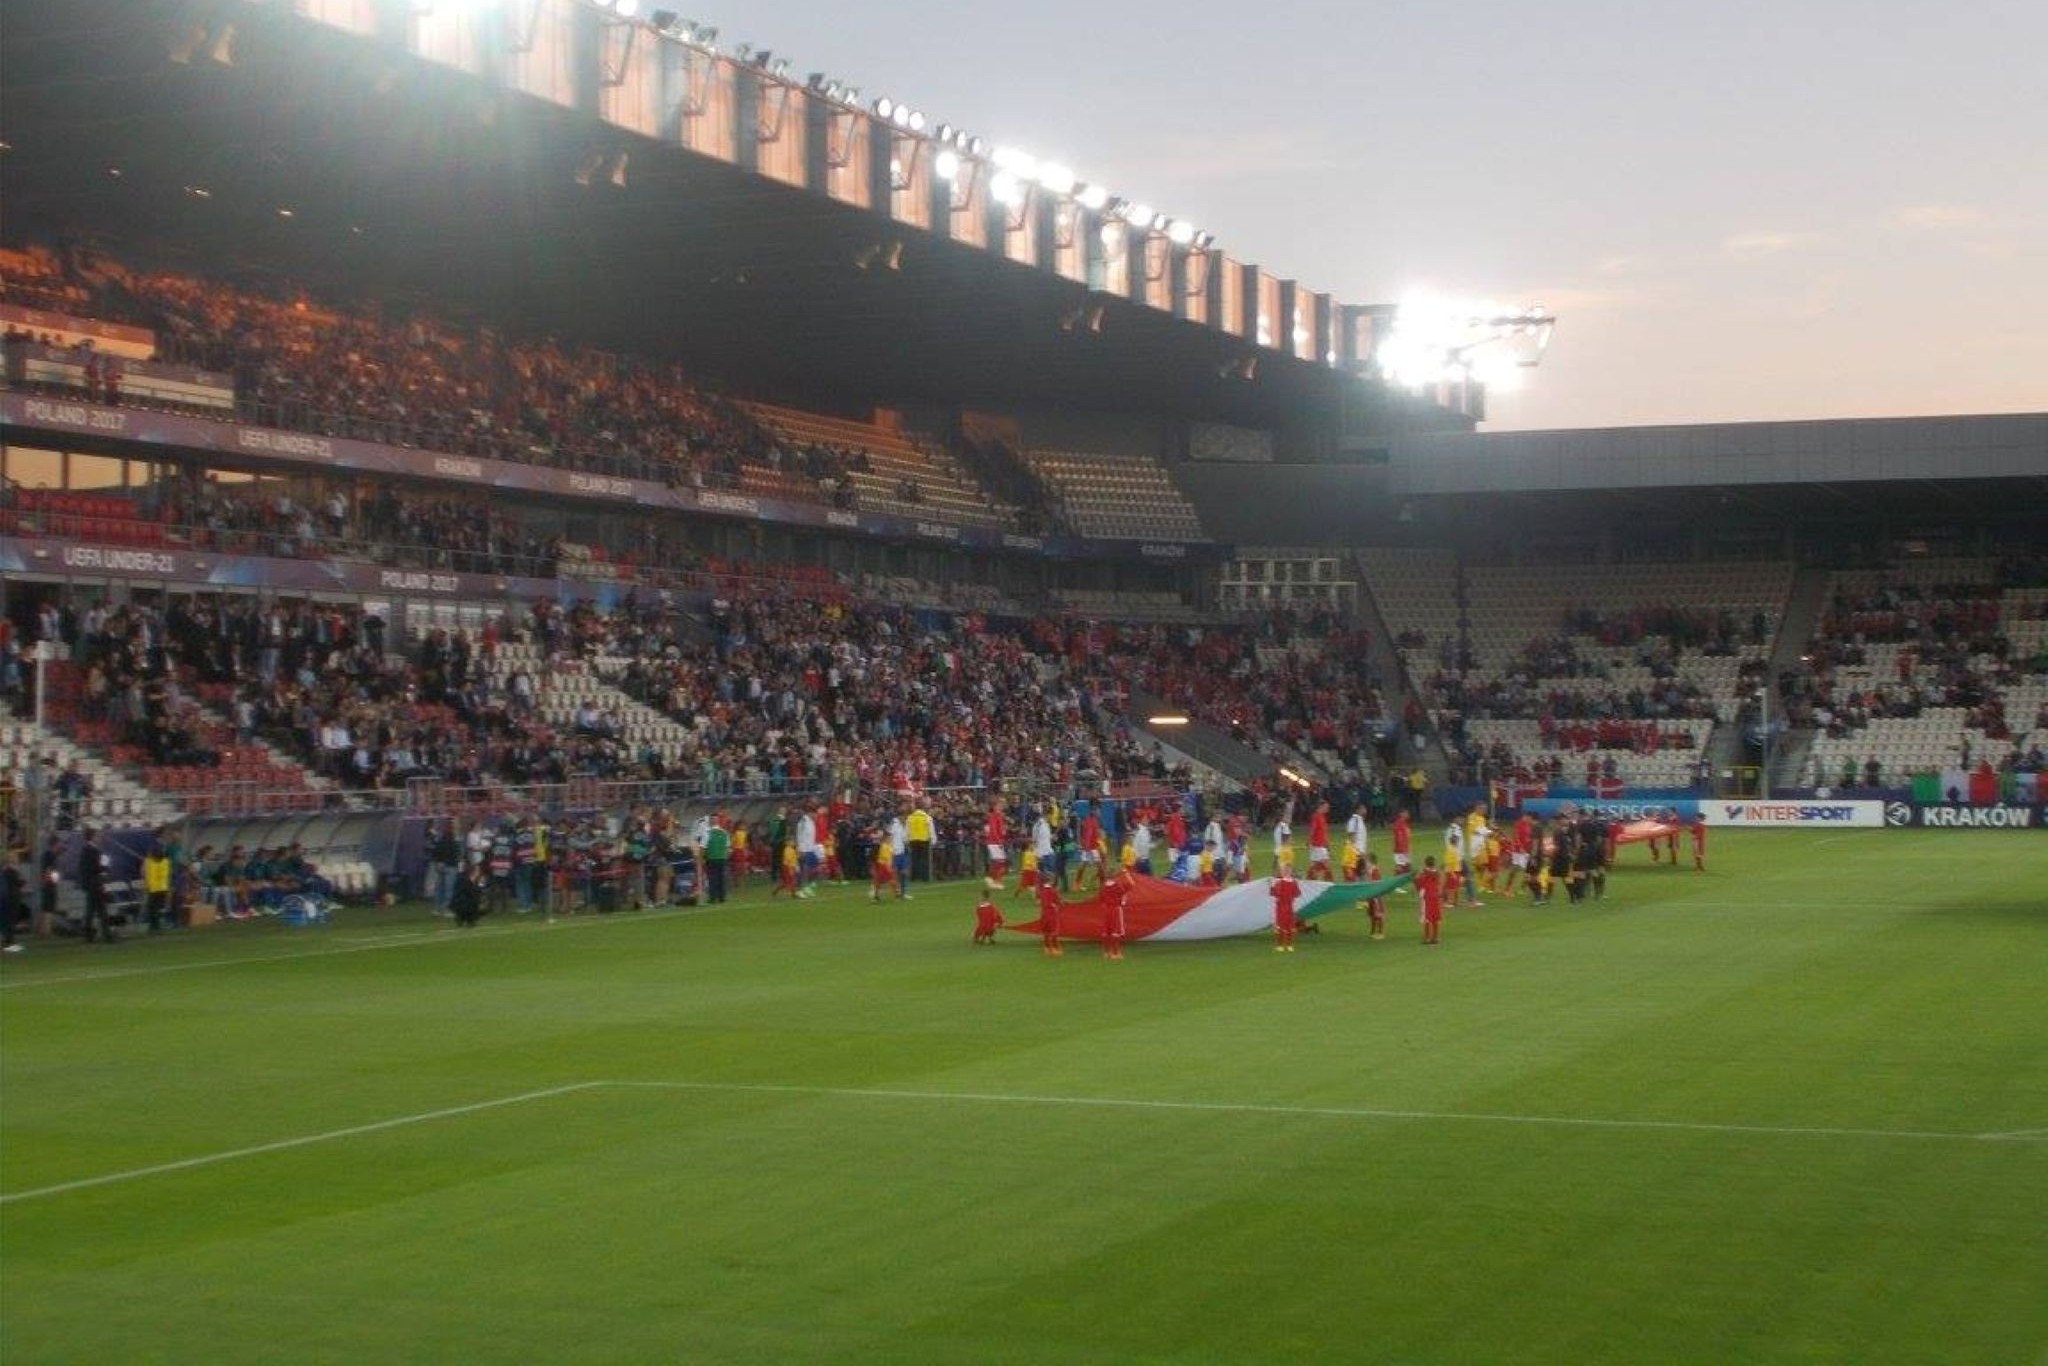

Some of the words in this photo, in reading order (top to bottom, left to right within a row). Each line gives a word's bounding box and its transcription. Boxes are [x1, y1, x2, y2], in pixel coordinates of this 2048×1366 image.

[25, 399, 86, 425] POLAND
[63, 547, 101, 567] UEFA
[103, 550, 175, 572] UNDER-21
[1747, 806, 1854, 820] INTERSPORT
[1924, 802, 2031, 826] KRAKÓW
